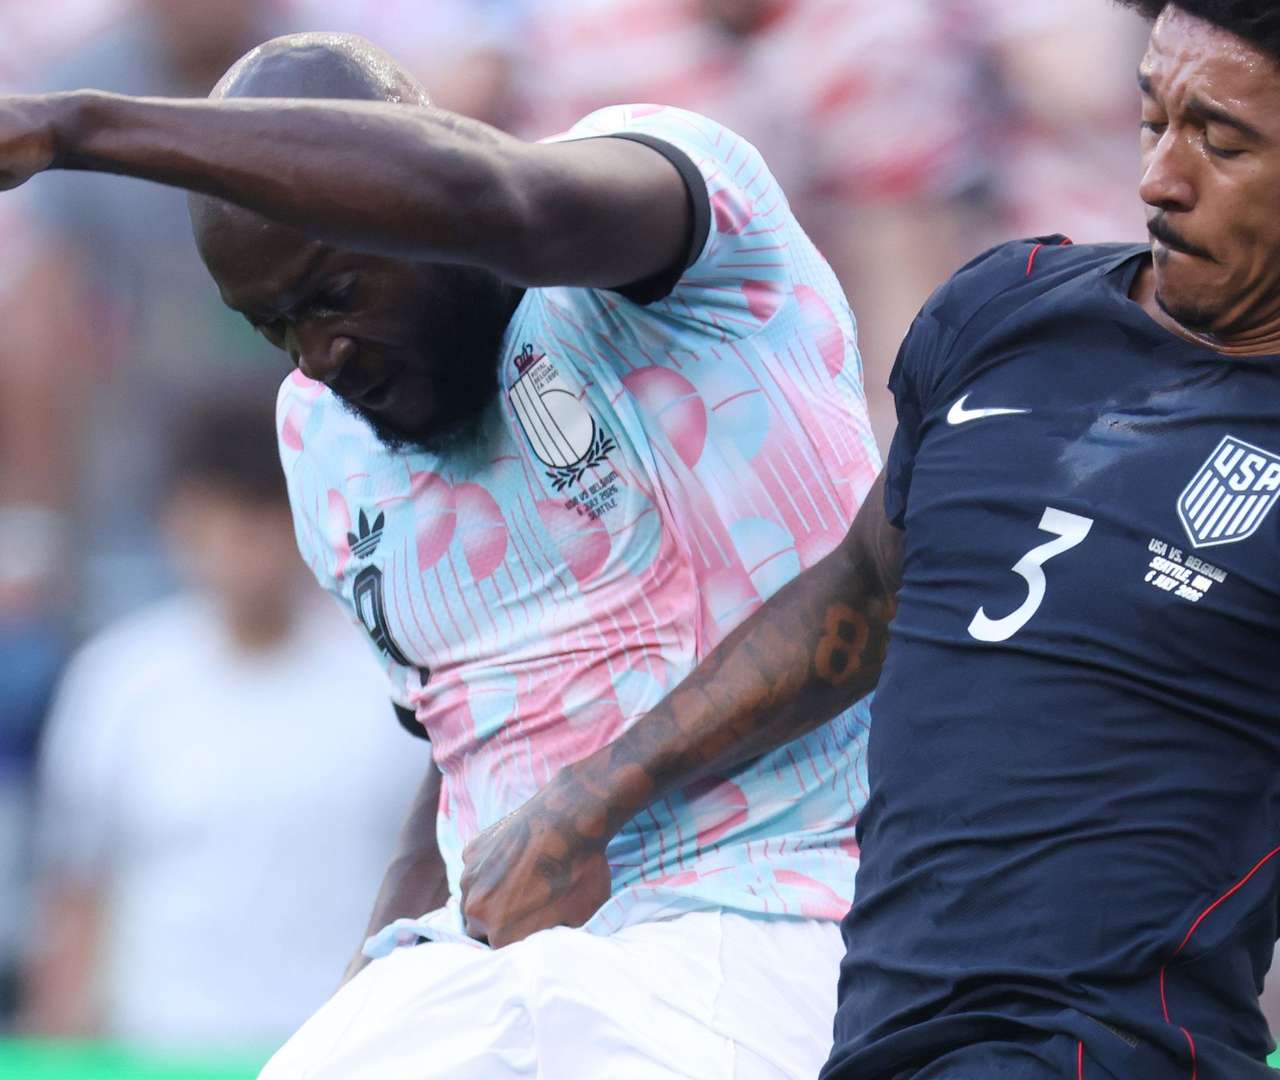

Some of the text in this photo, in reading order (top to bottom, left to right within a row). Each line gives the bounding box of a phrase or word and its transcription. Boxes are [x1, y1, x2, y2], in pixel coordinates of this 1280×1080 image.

[967, 506, 1095, 642] 3
[1148, 538, 1168, 556] USA
[1184, 555, 1228, 583] BELGIUM
